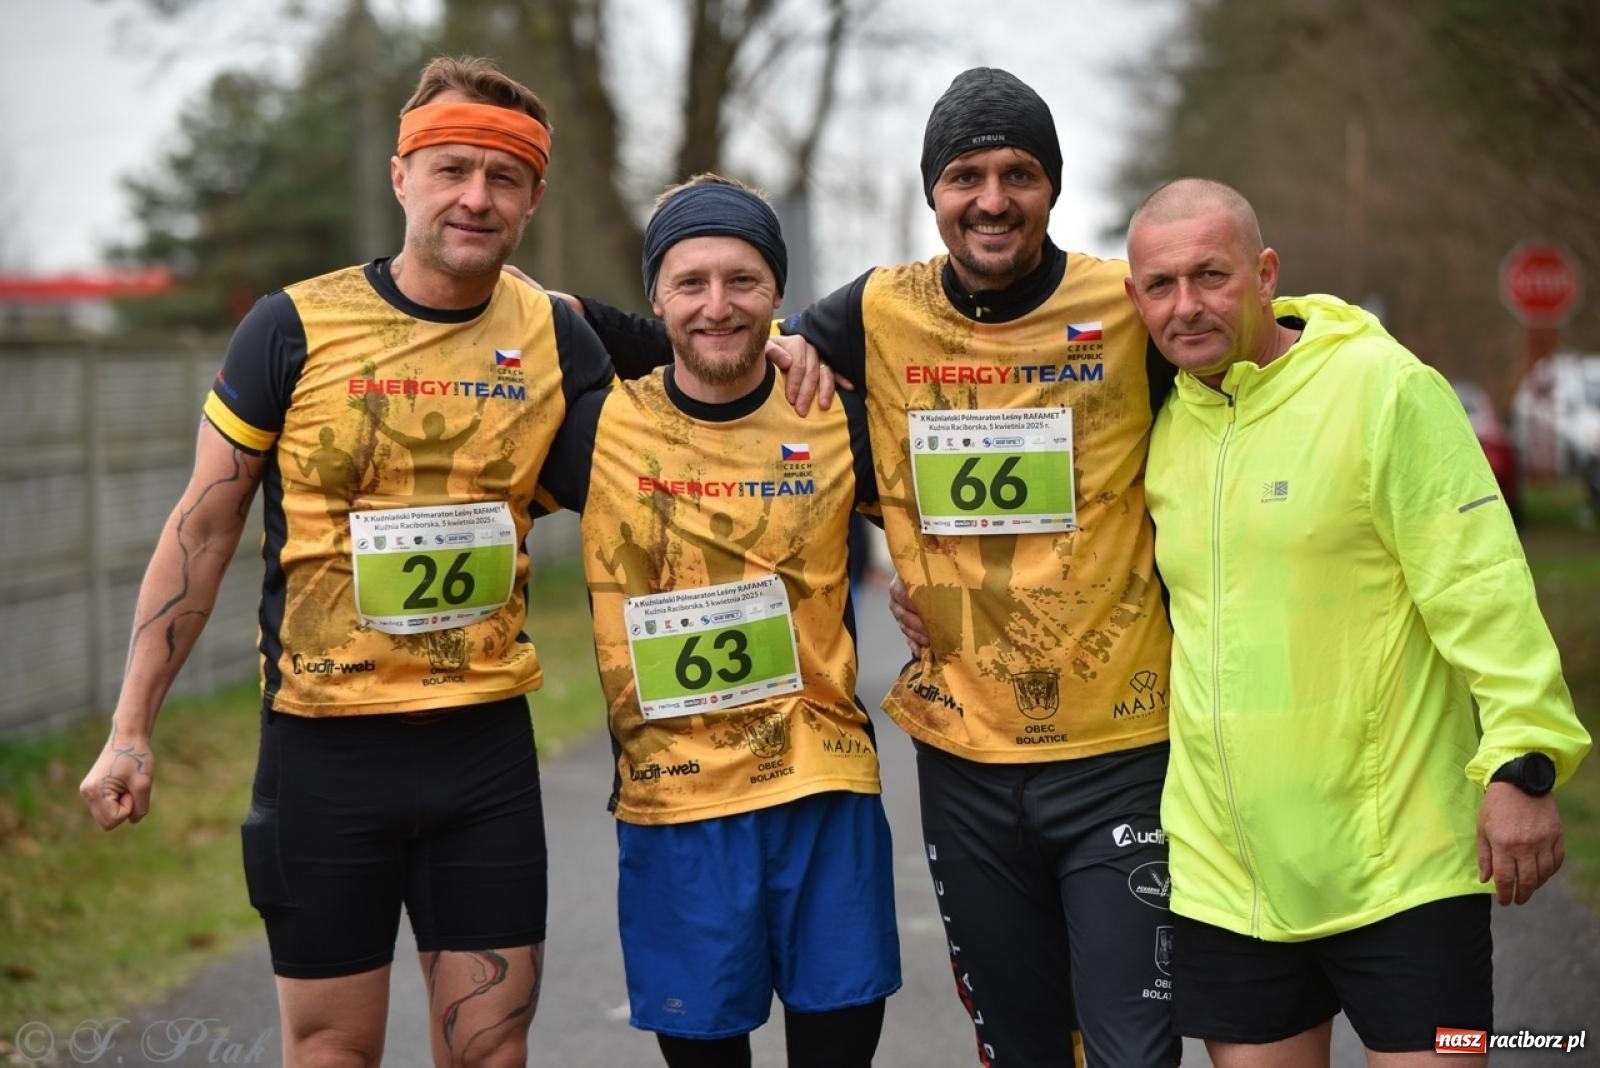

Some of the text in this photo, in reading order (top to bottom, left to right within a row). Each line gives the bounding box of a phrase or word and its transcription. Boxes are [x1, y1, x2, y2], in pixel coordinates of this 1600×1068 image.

[972, 134, 1005, 145] KIPRUN
[1067, 344, 1103, 352] CZECH
[1067, 353, 1103, 361] REPUBLIC
[906, 365, 1012, 384] ENERGY
[1020, 363, 1104, 383] TEAM
[348, 379, 452, 396] ENERGY
[459, 381, 526, 400] TEAM
[961, 412, 1000, 421] Półmaraton
[1002, 413, 1021, 421] Leśny
[1023, 411, 1060, 420] RAFAMET
[995, 422, 1025, 430] kwietnia
[784, 471, 813, 479] REPUBLIC
[638, 476, 738, 497] ENERGY
[745, 480, 814, 497] TEAM
[951, 456, 1028, 511] 66
[402, 552, 475, 610] 26
[740, 591, 759, 601] 2025
[675, 629, 752, 690] 63
[1025, 724, 1055, 734] OBEC
[1016, 734, 1068, 745] BOLATICE
[758, 759, 784, 772] OBEC
[750, 766, 795, 784] BOLATICE
